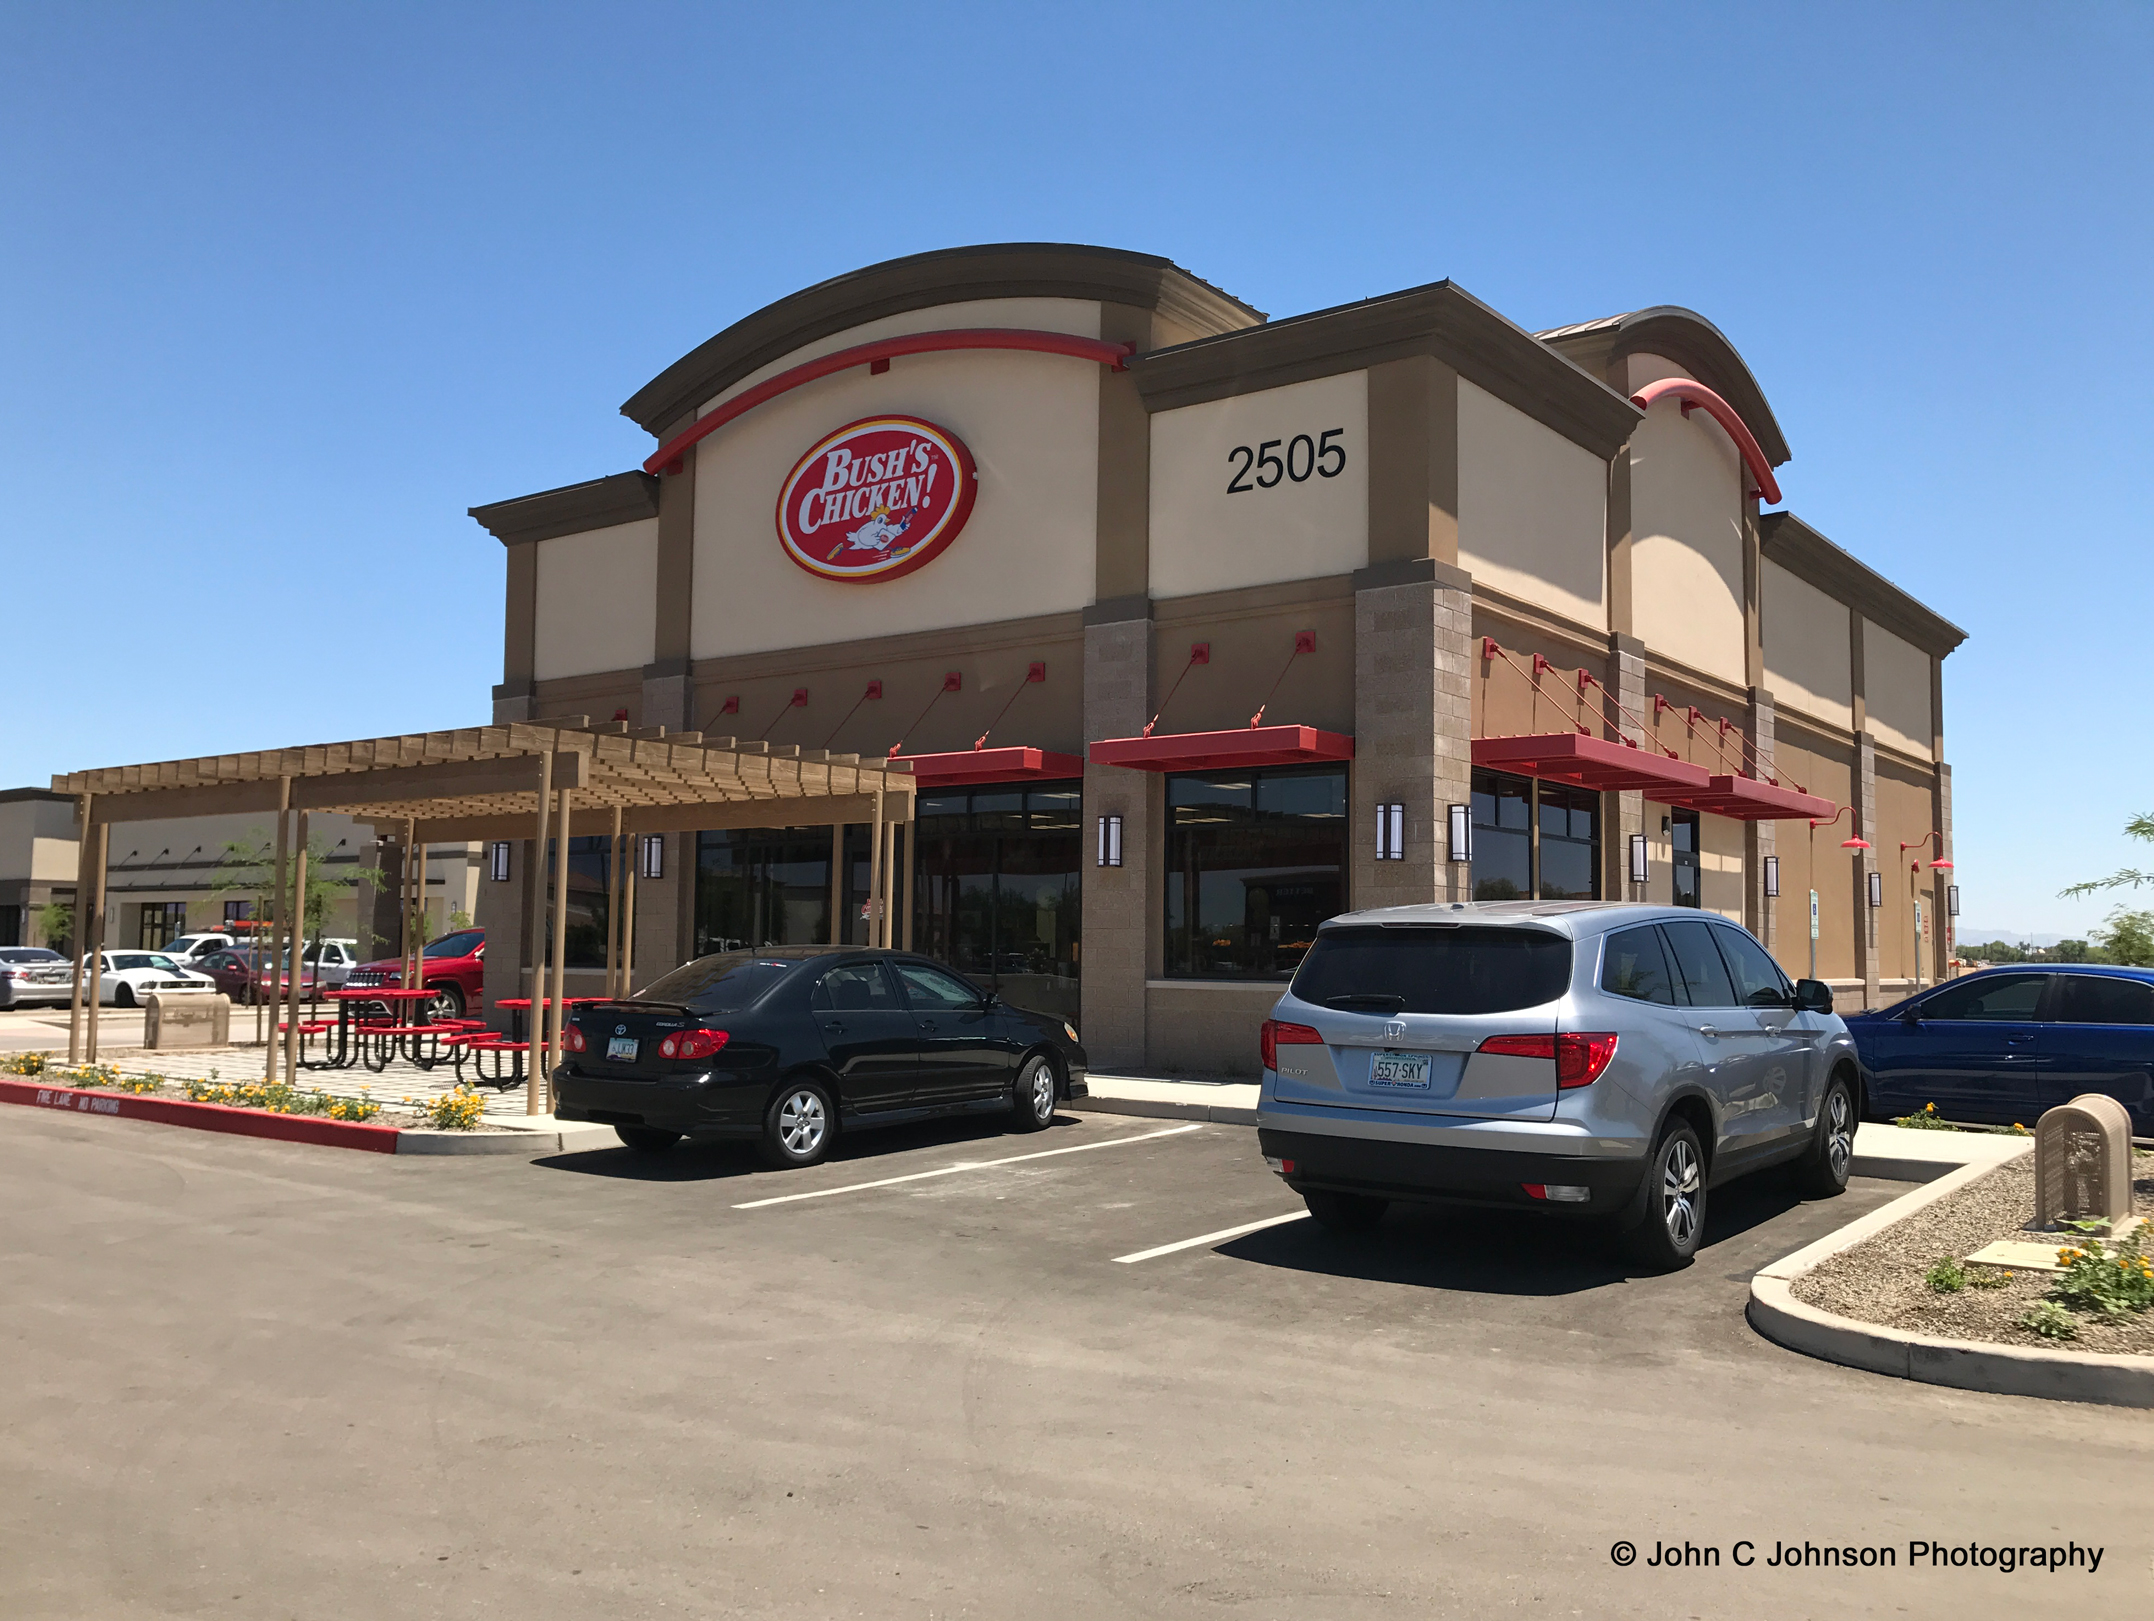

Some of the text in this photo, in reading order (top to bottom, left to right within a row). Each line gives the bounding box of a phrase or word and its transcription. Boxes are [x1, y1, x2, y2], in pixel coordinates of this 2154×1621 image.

[821, 439, 932, 493] BUSH'S
[1226, 427, 1346, 494] 2505
[799, 463, 938, 535] CHICKEN!
[1281, 1067, 1308, 1076] PILOT
[36, 1089, 120, 1114] FIRE LANE NO PARKING
